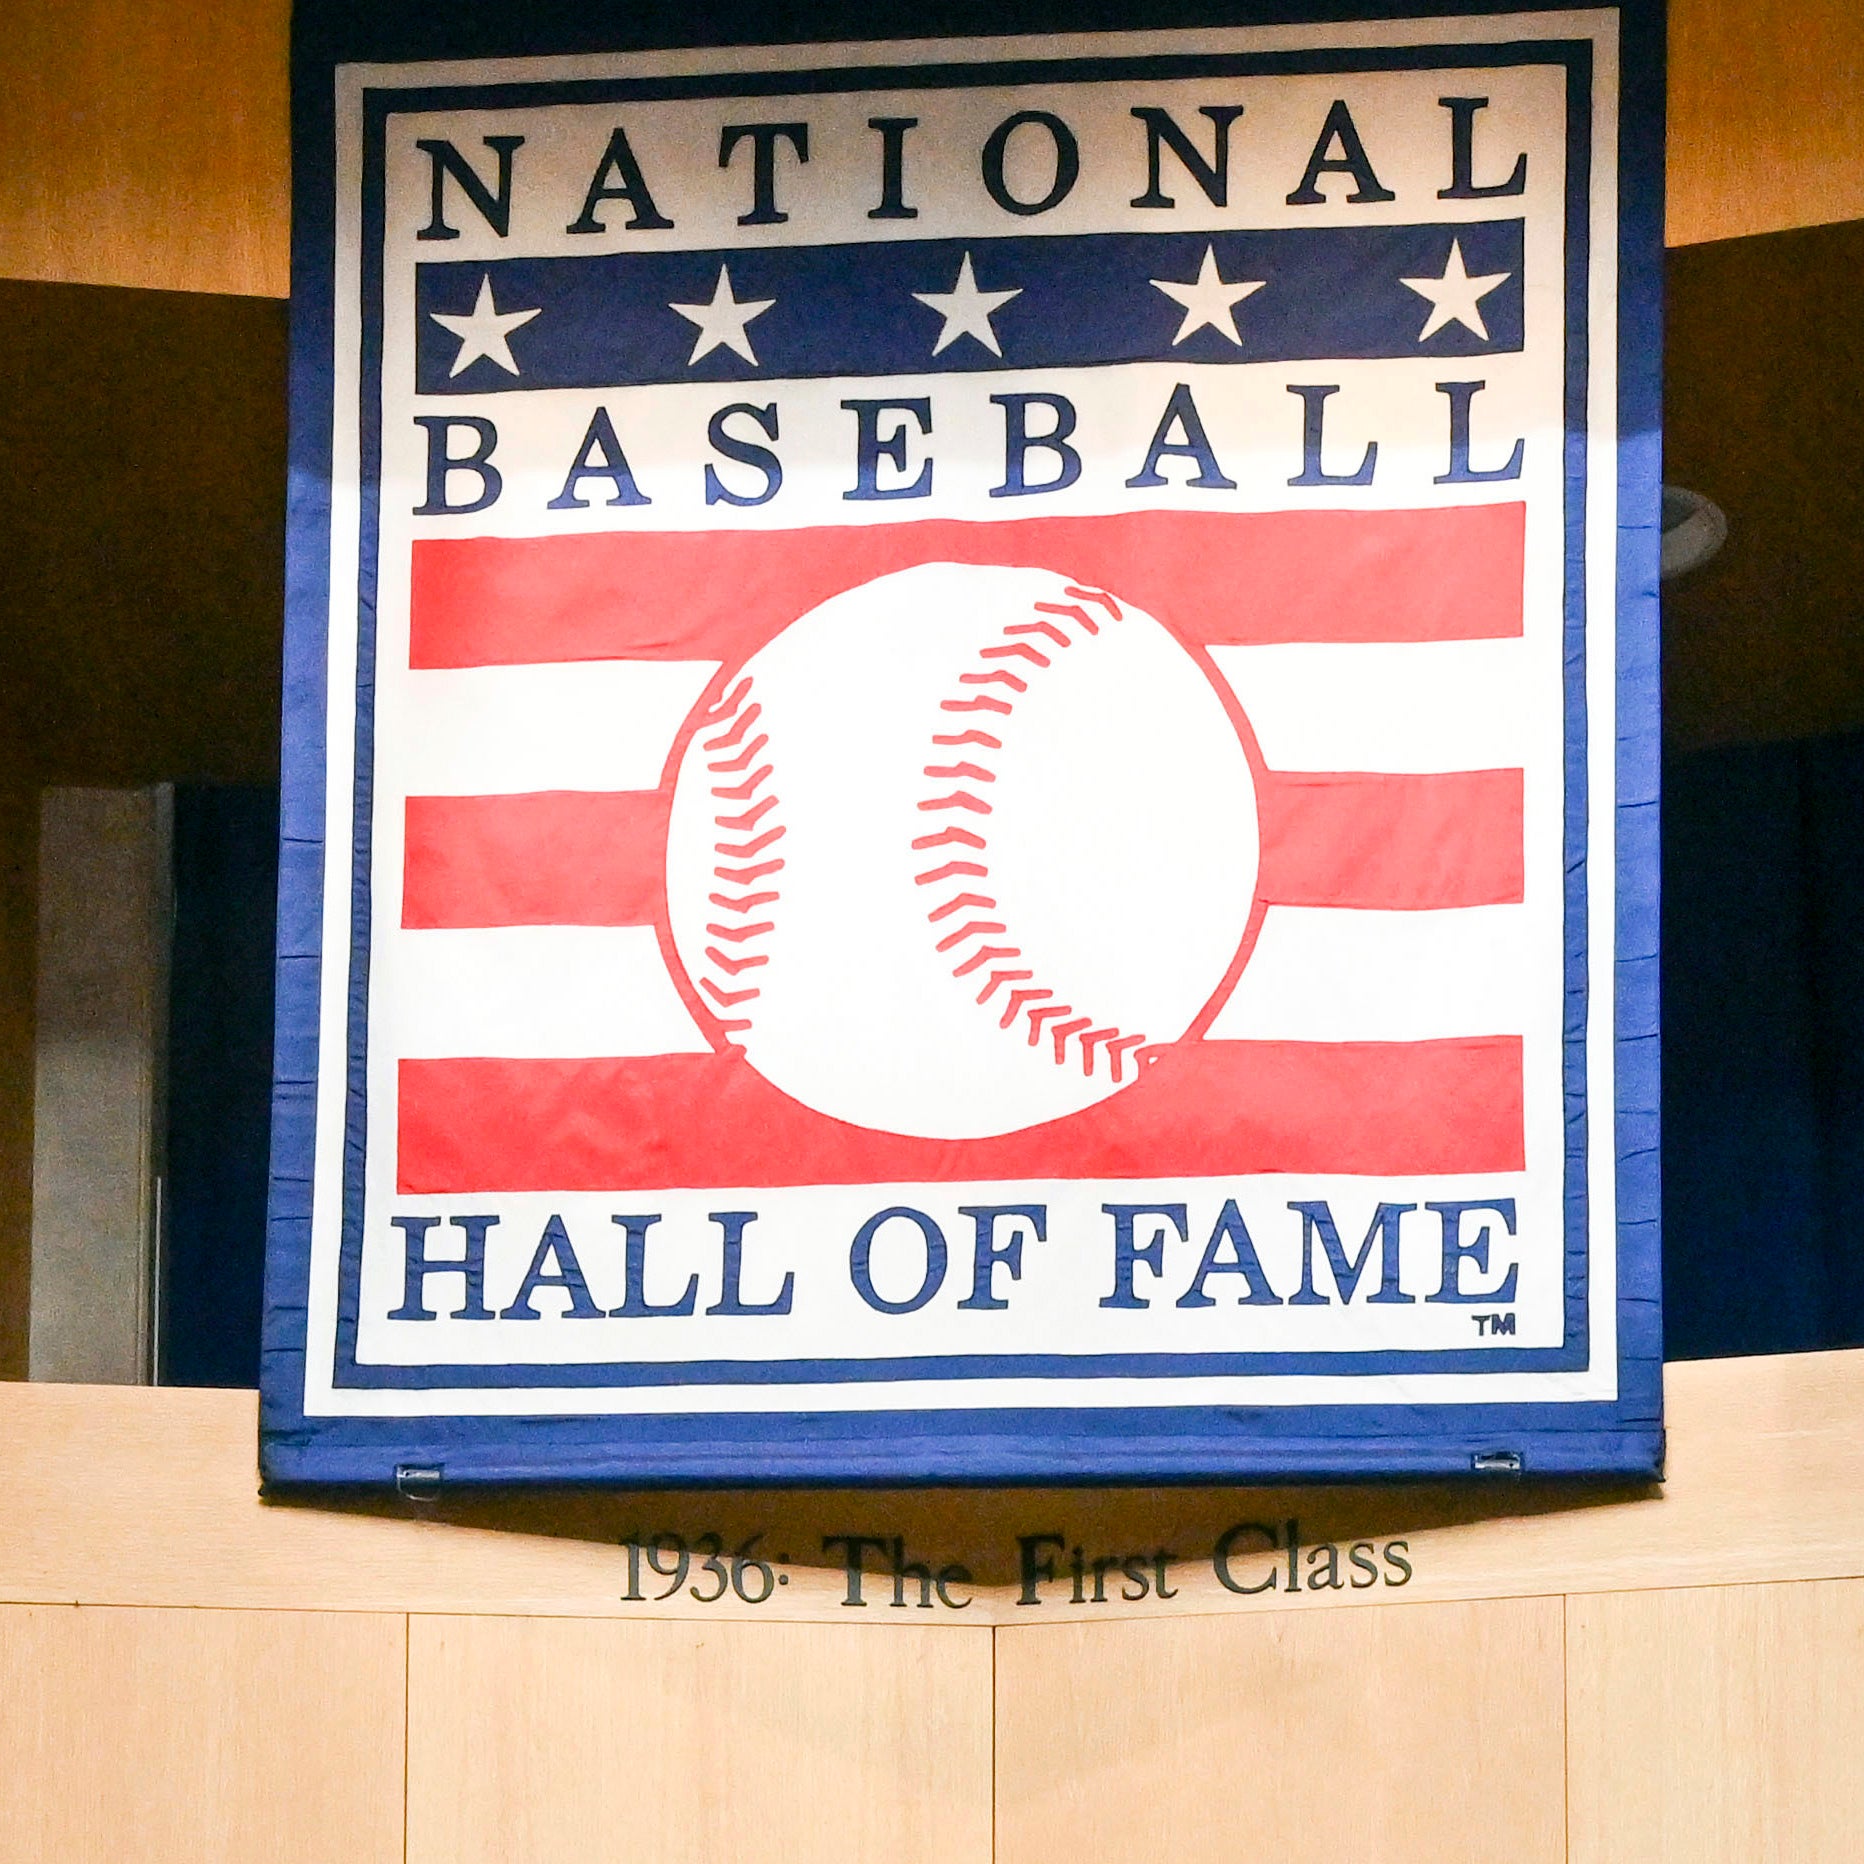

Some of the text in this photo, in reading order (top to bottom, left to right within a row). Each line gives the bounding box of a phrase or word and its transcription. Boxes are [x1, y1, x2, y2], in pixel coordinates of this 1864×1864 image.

[415, 95, 1527, 241] NATIONAL
[413, 380, 1525, 516] BASEBALL
[387, 1196, 1520, 1323] HALL OF FAME
[619, 1518, 1415, 1609] 1936: The First Class
